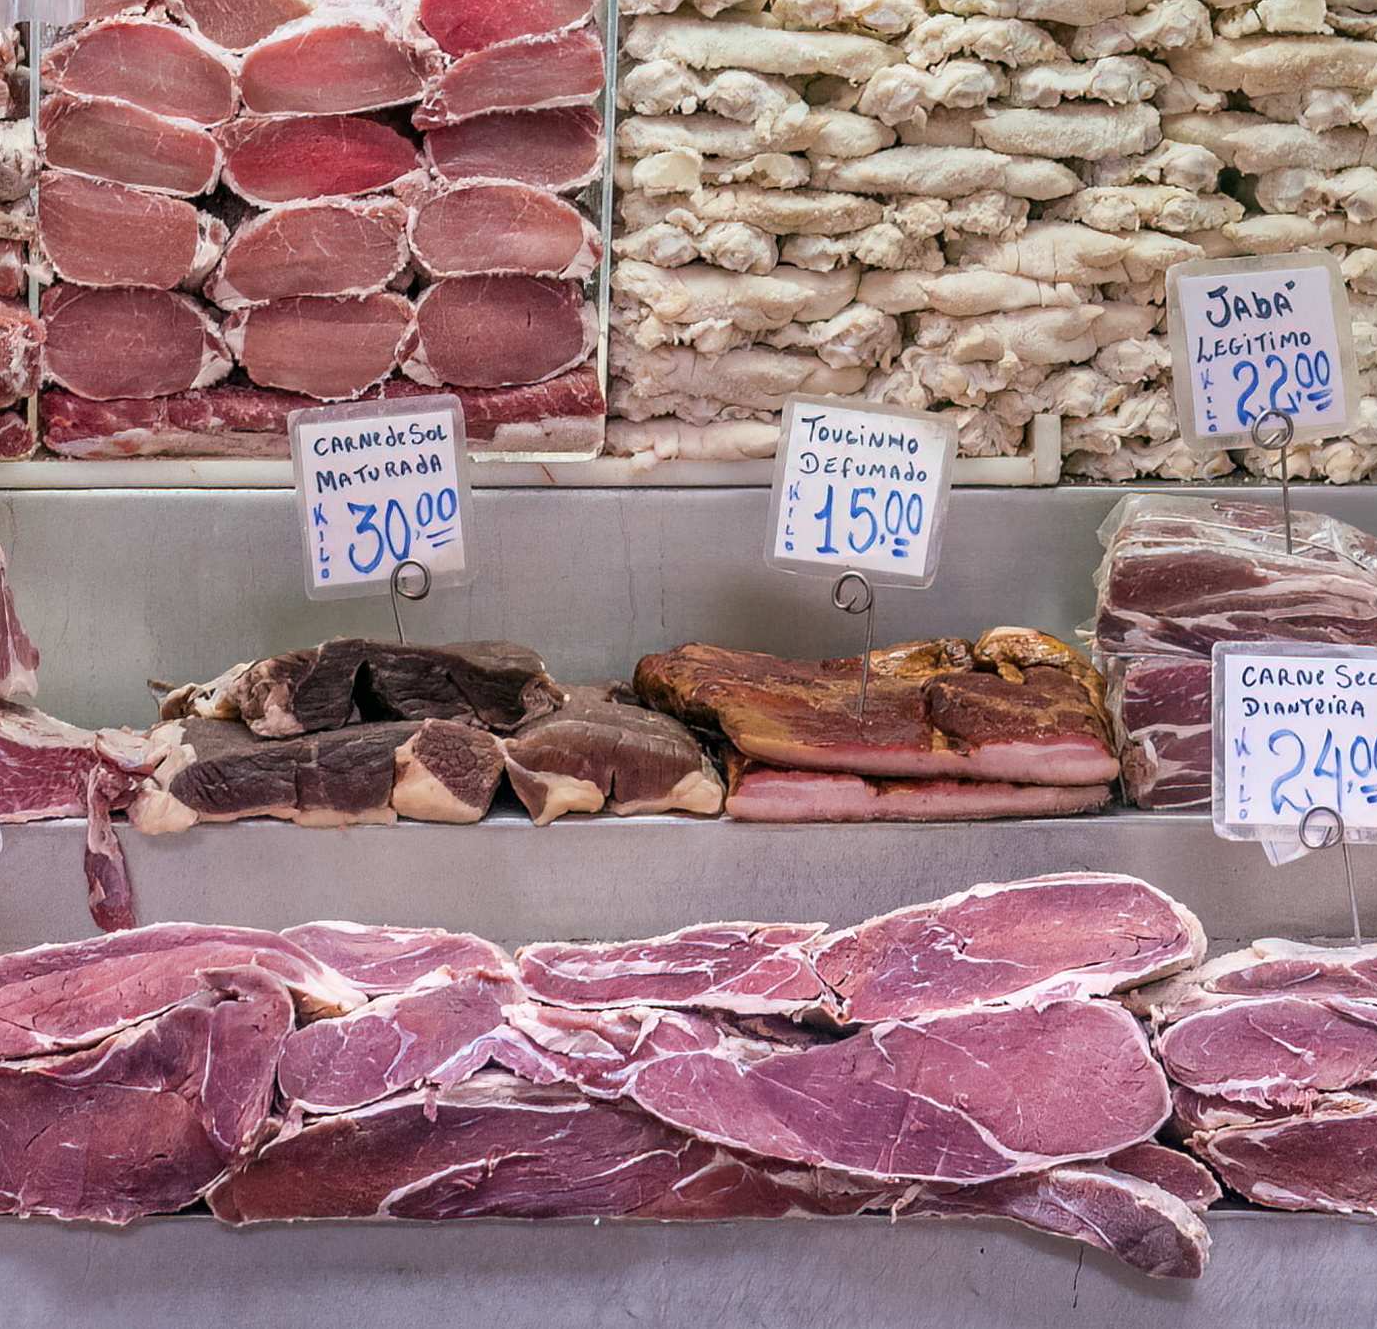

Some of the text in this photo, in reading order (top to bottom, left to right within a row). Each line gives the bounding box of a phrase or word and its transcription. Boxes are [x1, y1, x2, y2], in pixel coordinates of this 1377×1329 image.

[1233, 350, 1330, 427] 22,00
[313, 503, 330, 579] KILO
[347, 487, 457, 574] 30,00
[785, 481, 801, 551] KILO
[814, 484, 923, 554] 15,00
[1234, 727, 1251, 819] KILO
